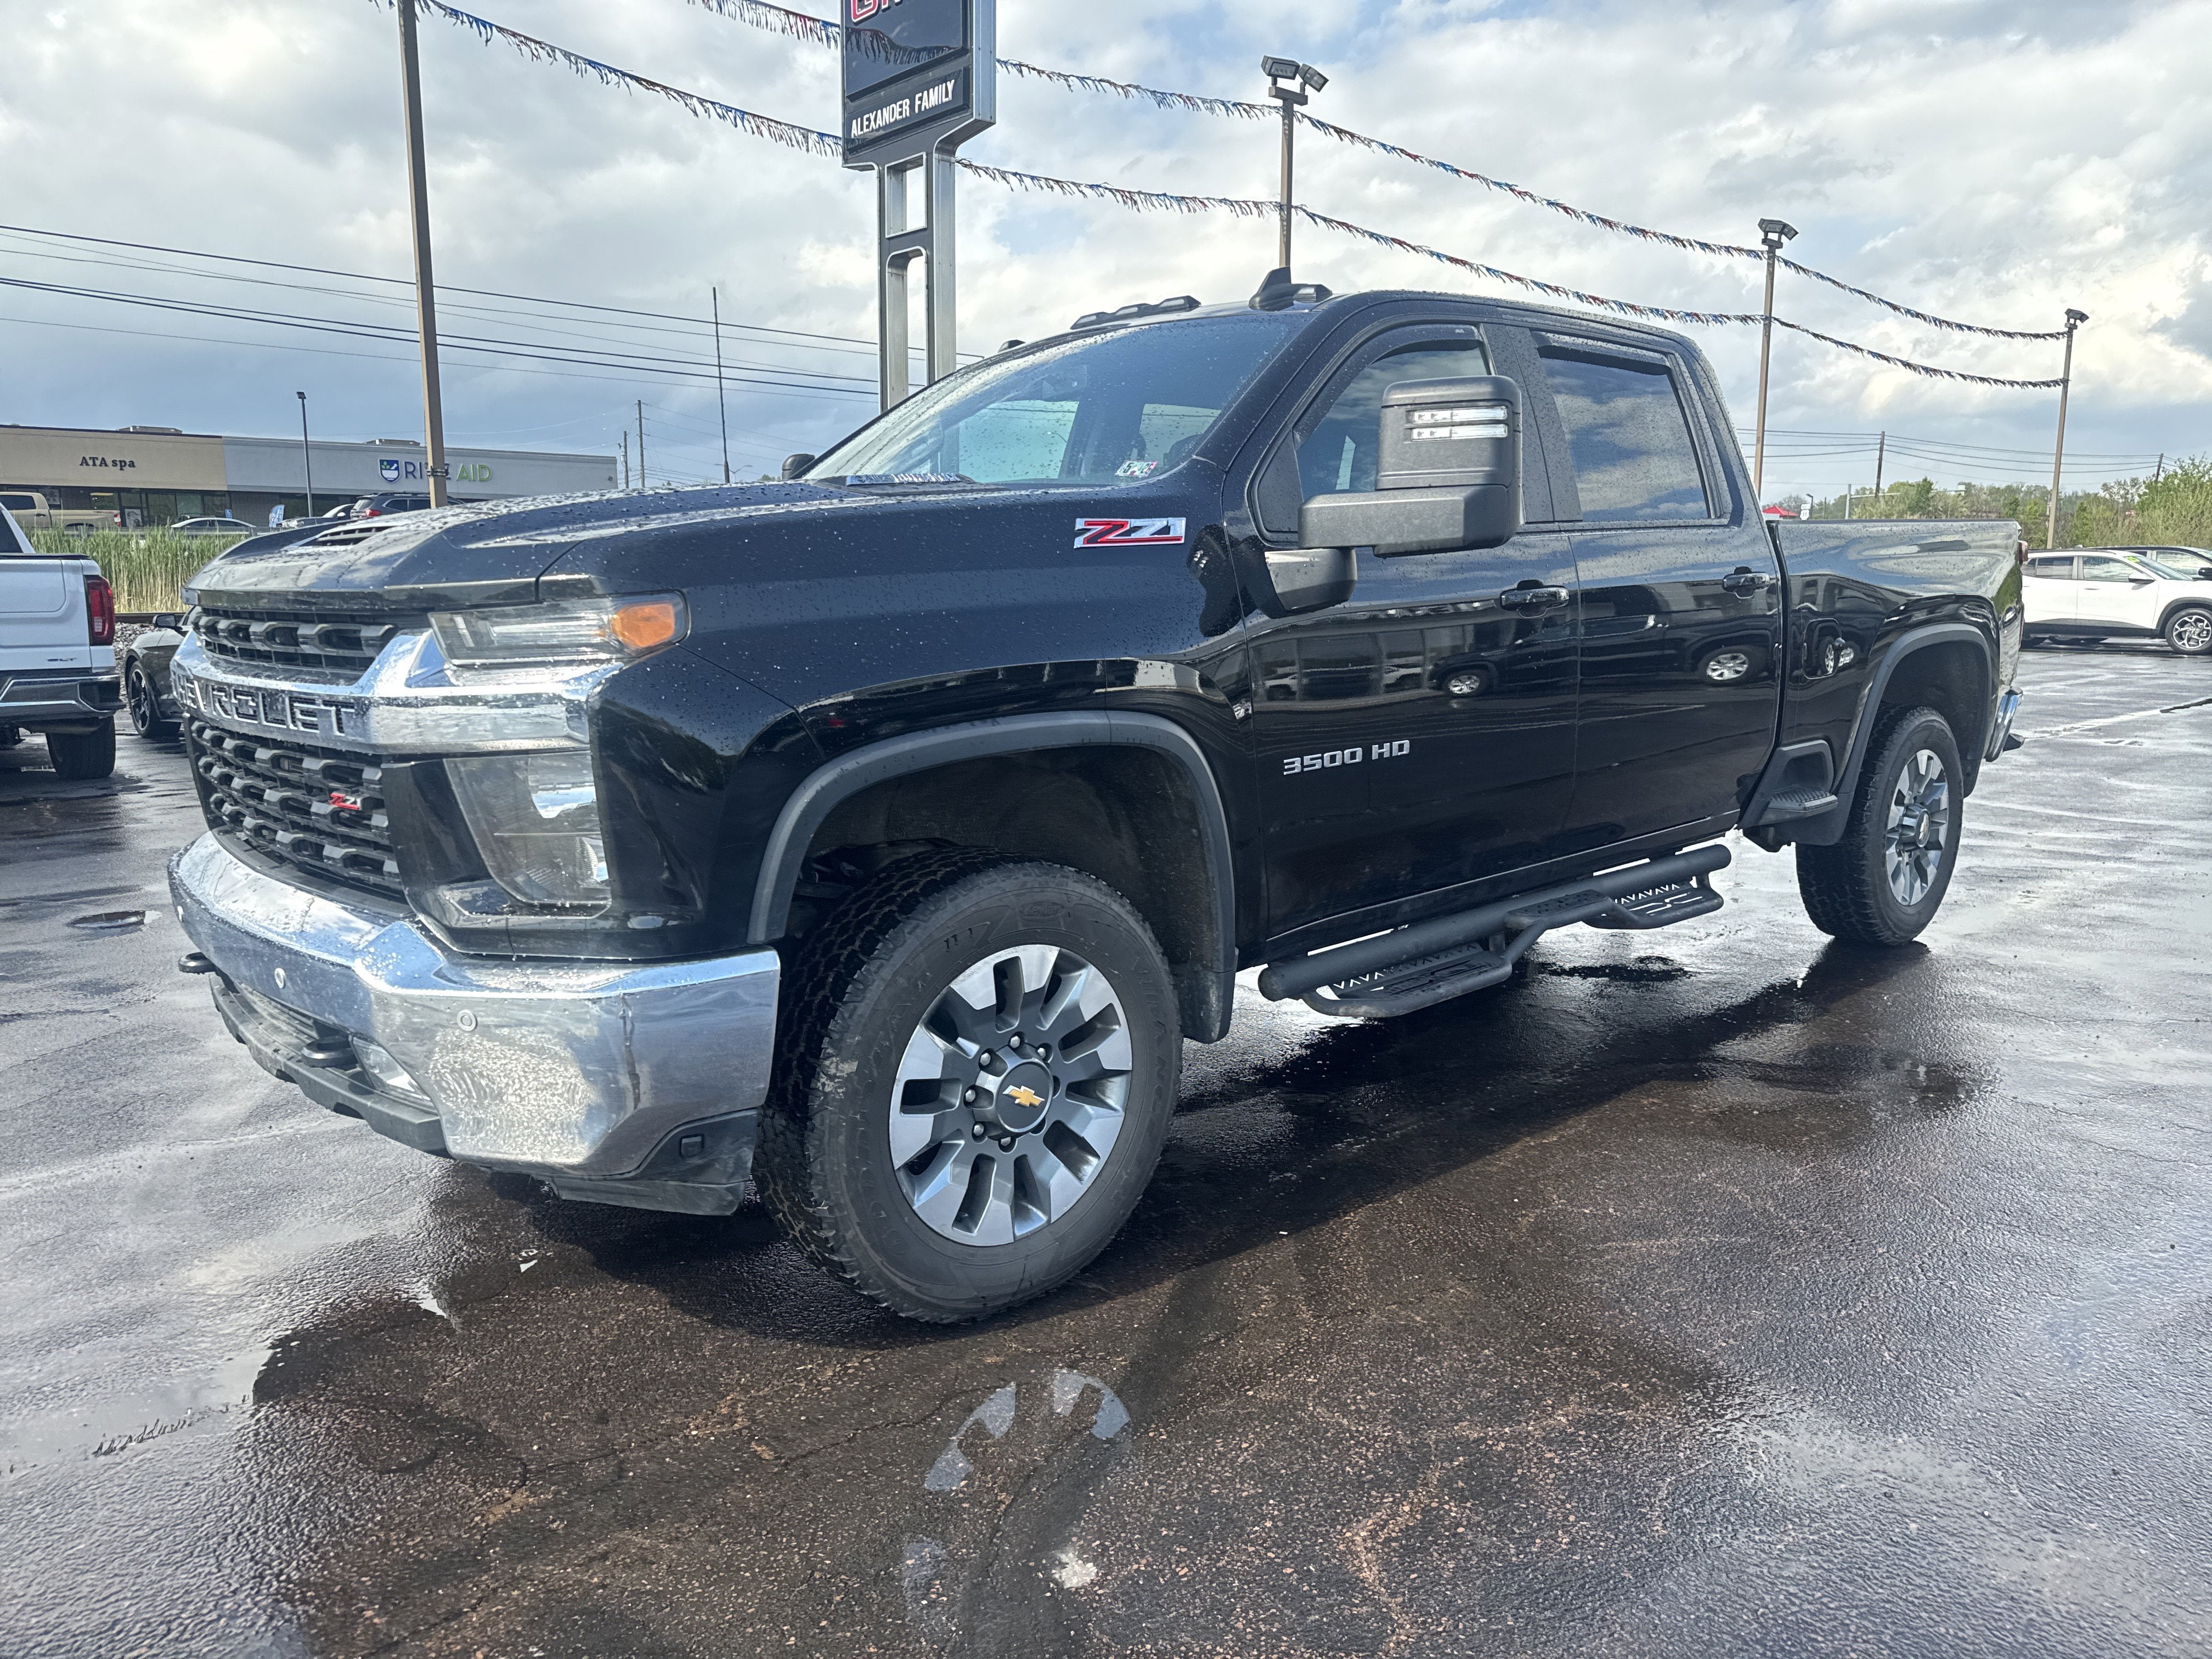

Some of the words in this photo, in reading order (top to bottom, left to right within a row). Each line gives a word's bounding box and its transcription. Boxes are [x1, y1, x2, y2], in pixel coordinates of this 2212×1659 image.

[851, 98, 911, 139] ALEXANDER
[915, 79, 955, 114] FAMILY
[79, 456, 109, 467] ATA
[111, 459, 136, 471] spa
[404, 461, 451, 480] RI
[456, 464, 492, 482] AID
[1074, 517, 1186, 549] Z71
[1283, 747, 1363, 775] 3500
[1372, 740, 1410, 760] HD
[330, 793, 362, 811] Z71
